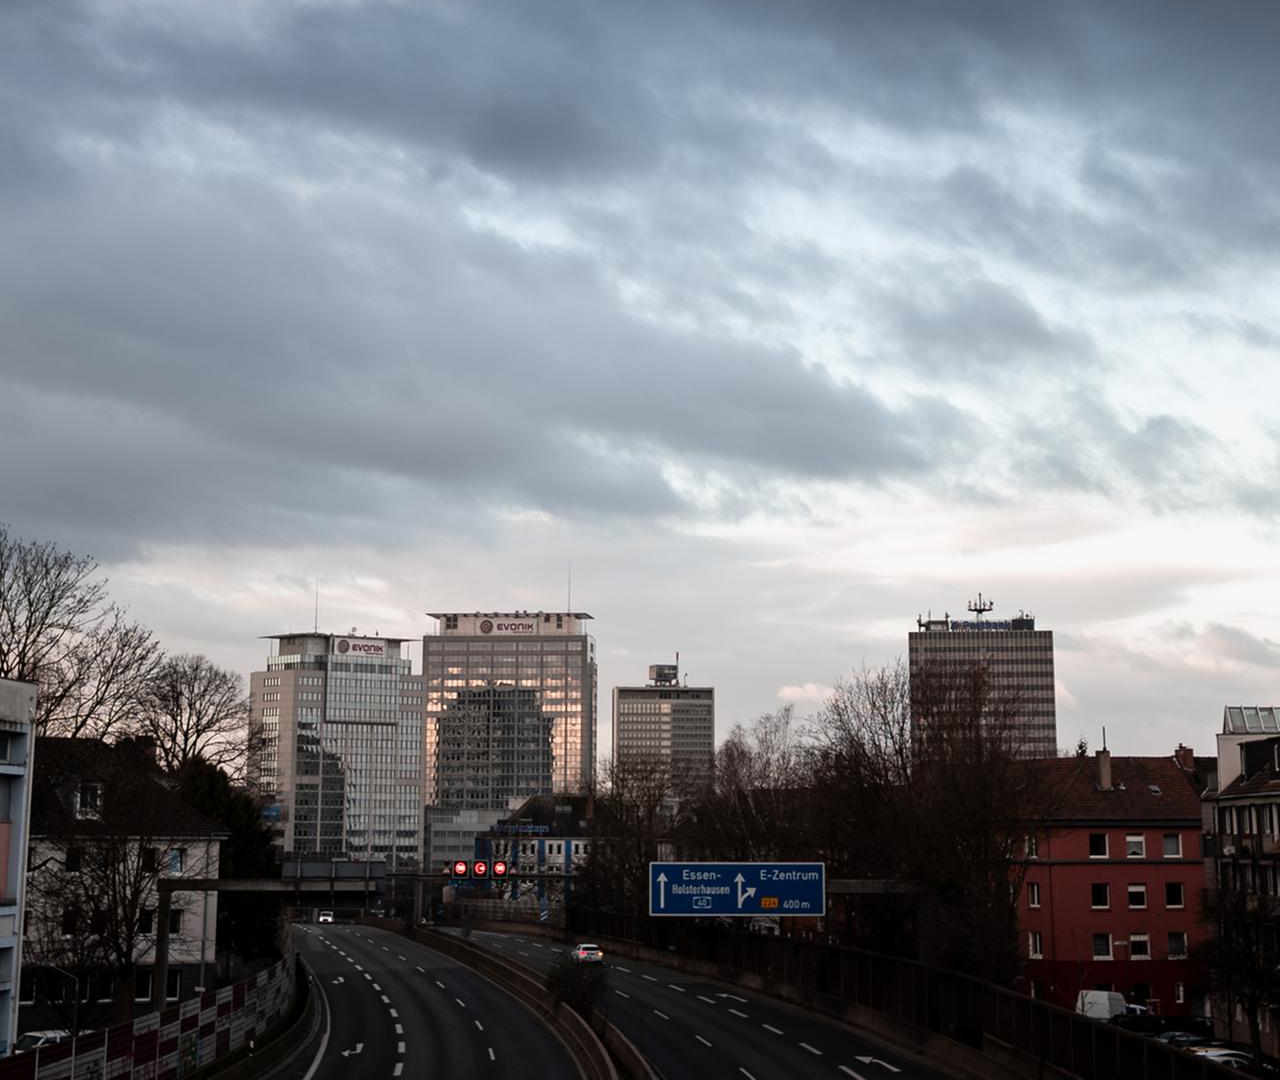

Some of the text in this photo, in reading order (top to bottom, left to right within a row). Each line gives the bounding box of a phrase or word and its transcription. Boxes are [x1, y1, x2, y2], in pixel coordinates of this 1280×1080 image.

[682, 869, 722, 881] Essen-
[760, 869, 819, 881] E-Zentrum
[672, 883, 731, 895] Holsterhausen
[697, 898, 708, 906] 40
[763, 898, 777, 907] 224
